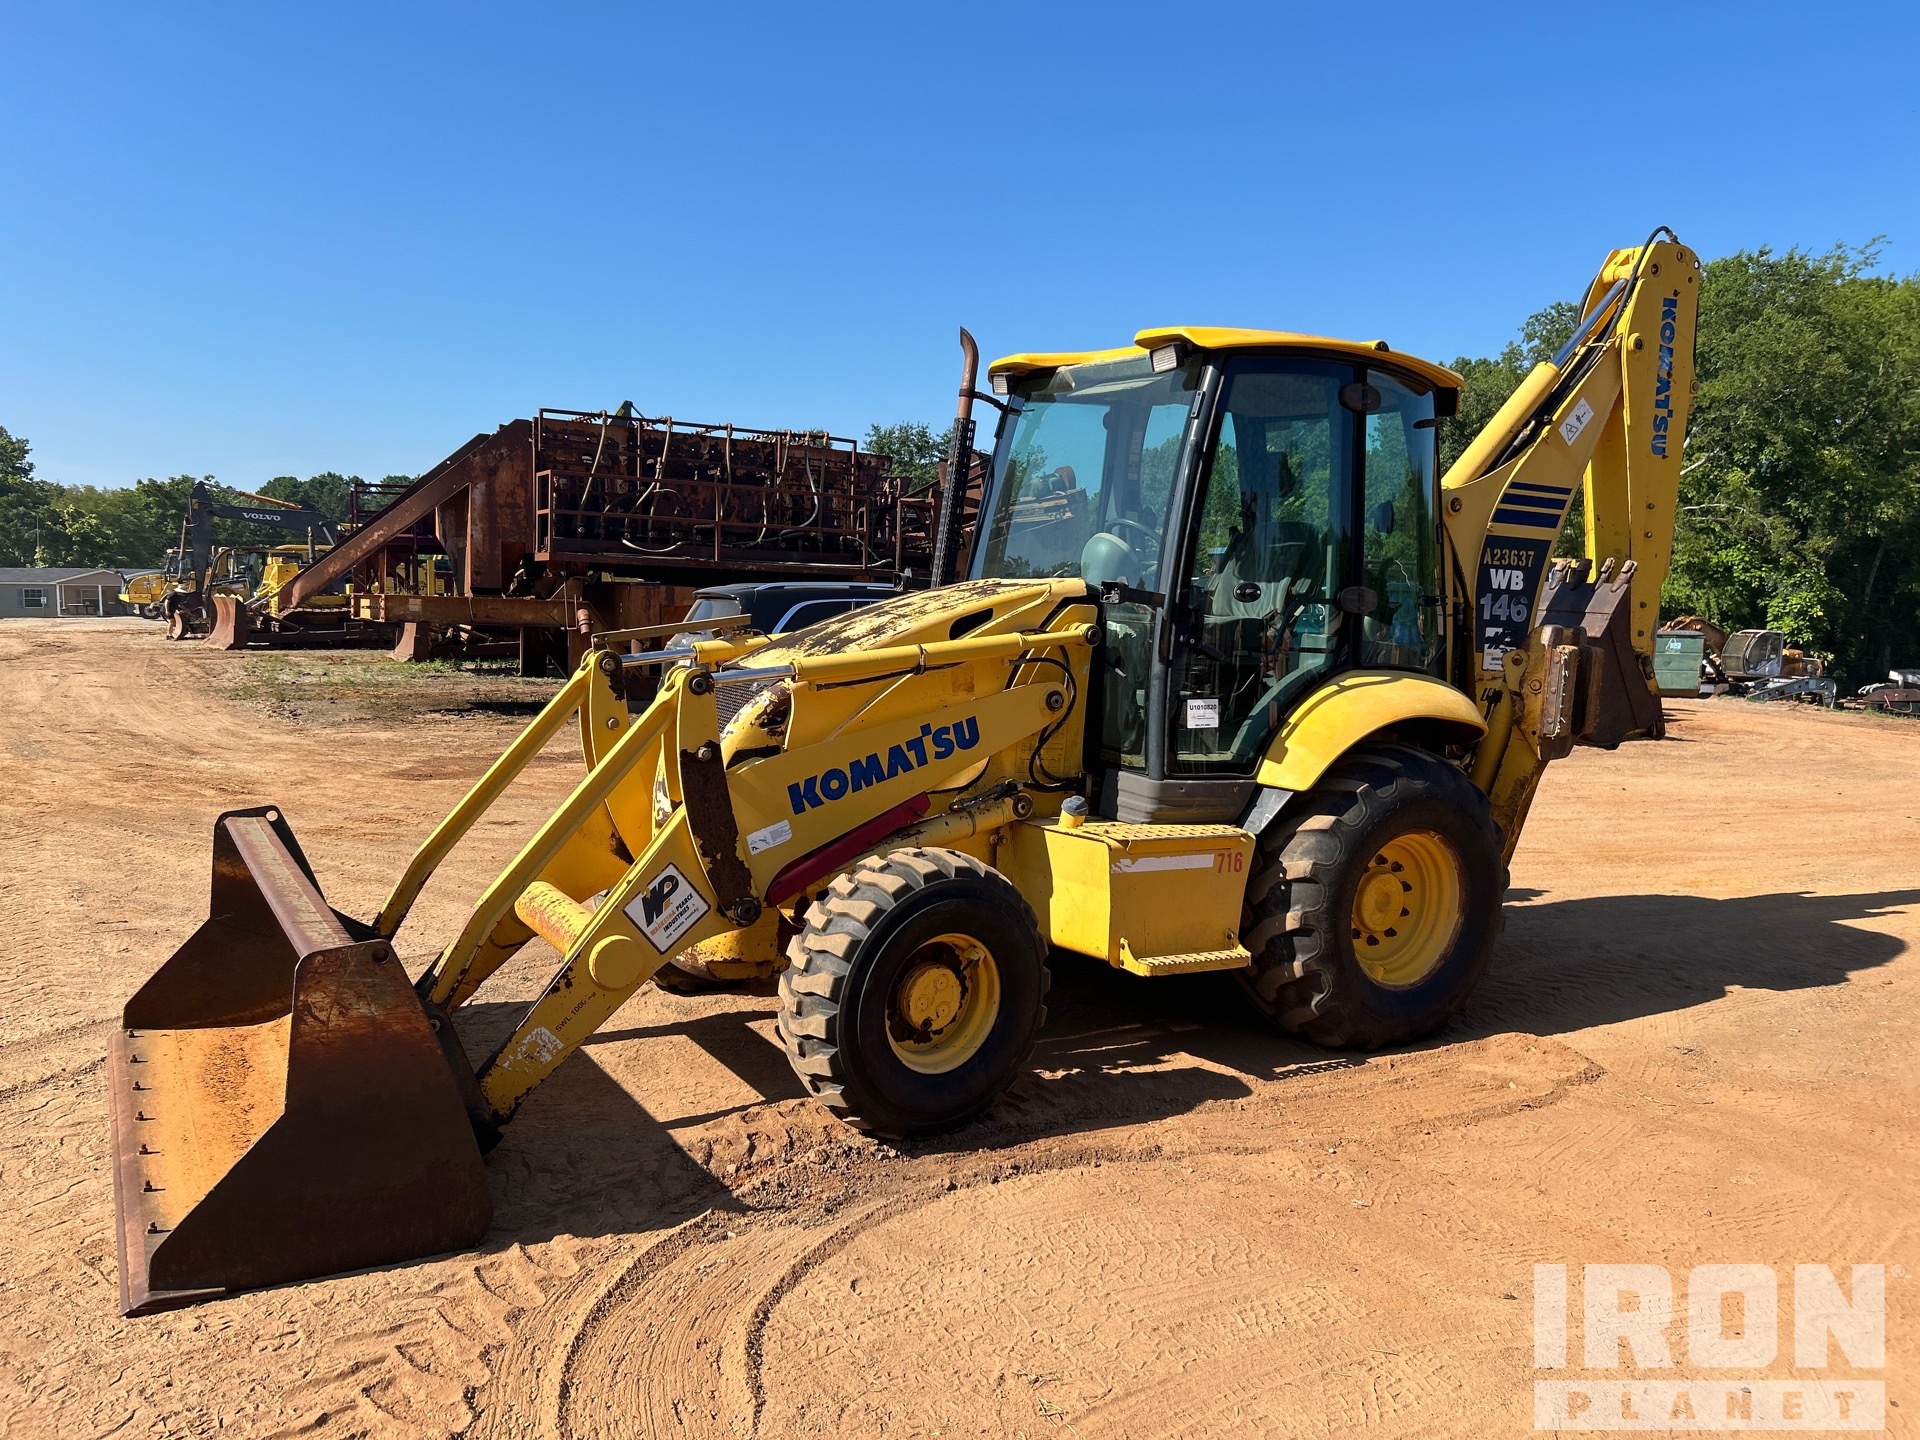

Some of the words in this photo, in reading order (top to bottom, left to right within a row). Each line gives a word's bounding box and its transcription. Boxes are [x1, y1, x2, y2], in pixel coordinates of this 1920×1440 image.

[1651, 298, 1678, 456] KOMATSU
[242, 512, 281, 521] VOLVO
[1483, 548, 1535, 568] A23637
[1489, 568, 1524, 591] WB
[1480, 593, 1528, 622] 146
[787, 715, 980, 815] KOMATSU
[1217, 852, 1243, 873] 716
[663, 905, 690, 932] INDUSTRIES
[555, 1016, 572, 1032] SWL
[571, 1000, 587, 1015] 1000
